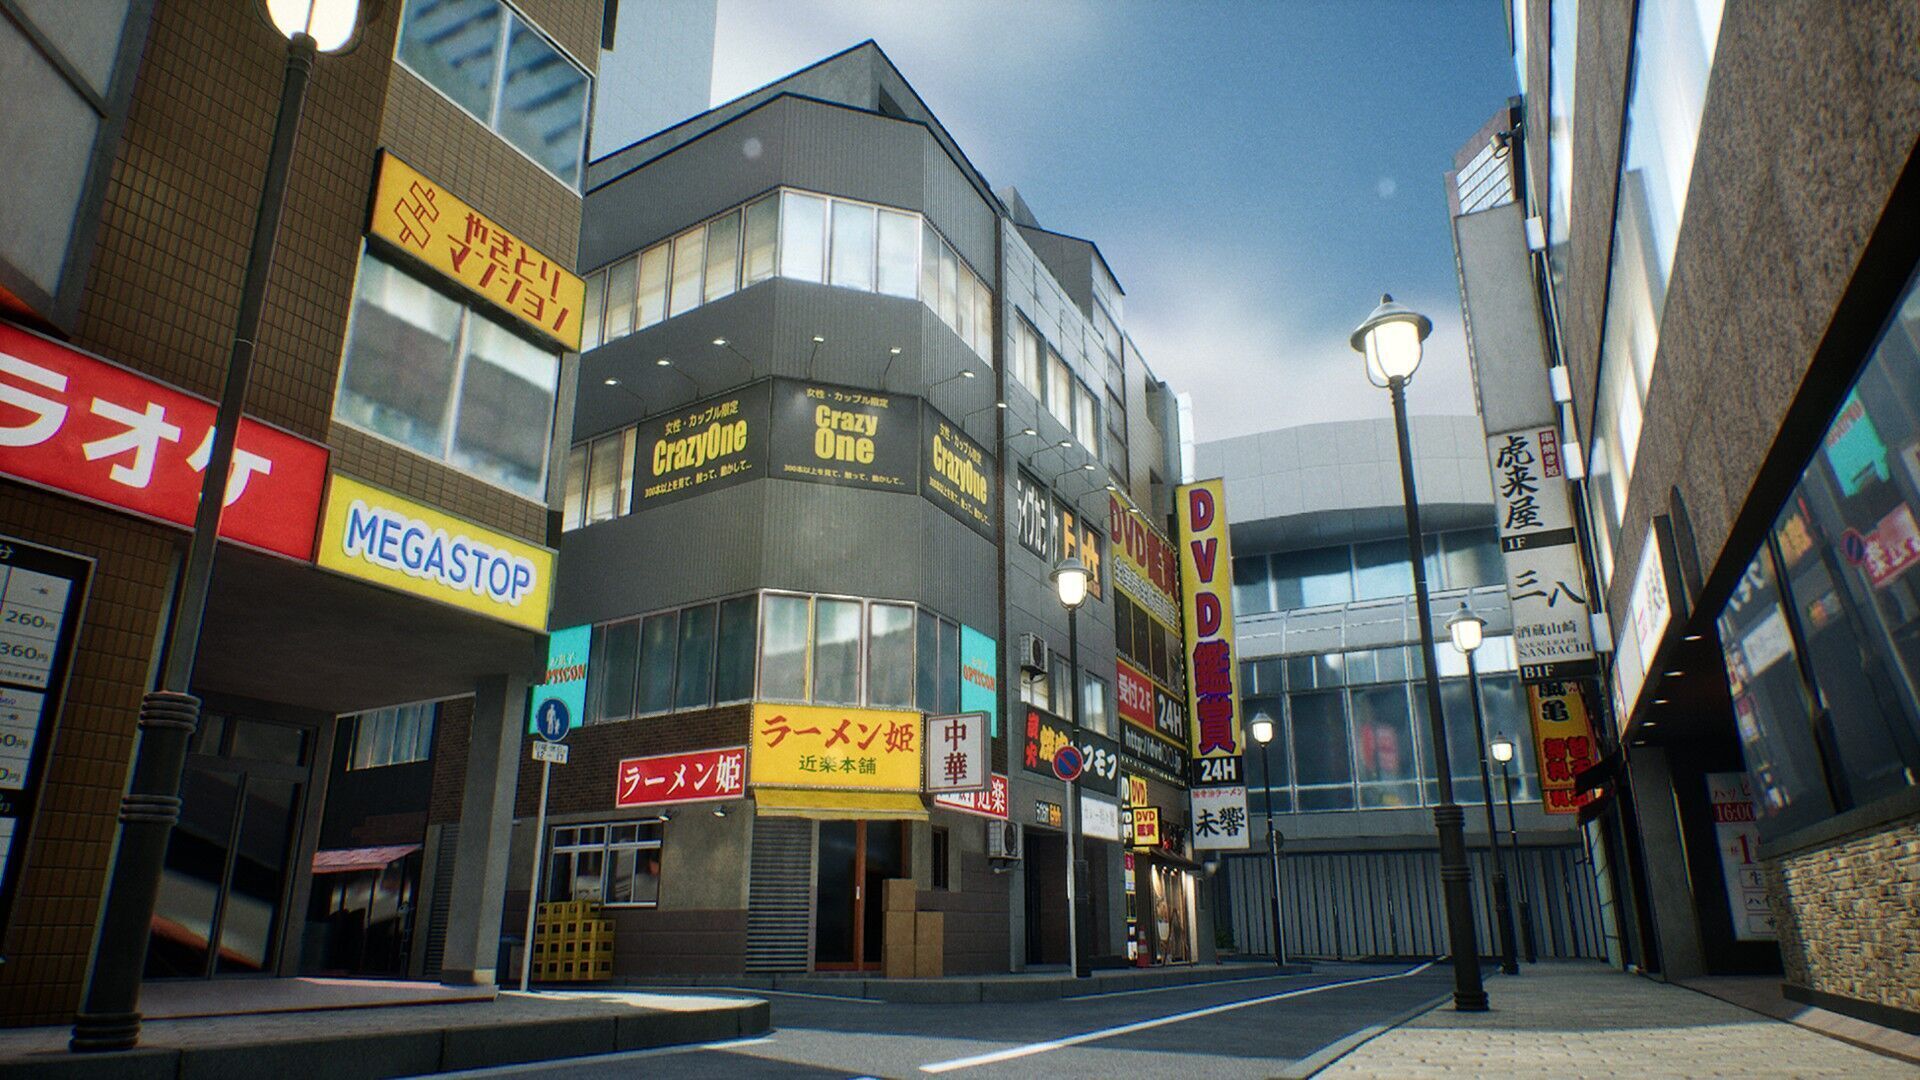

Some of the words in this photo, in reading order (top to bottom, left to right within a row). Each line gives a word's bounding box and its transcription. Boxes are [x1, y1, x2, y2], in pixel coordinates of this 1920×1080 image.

[463, 211, 562, 304] やきとり
[446, 233, 570, 332] マンション
[815, 404, 879, 437] Crazy
[652, 419, 748, 477] CrazyOne
[814, 428, 875, 465] One
[932, 434, 988, 506] CrazyOne
[1495, 434, 1544, 530] 虎来屋
[346, 507, 531, 600] MEGASTOP
[1507, 536, 1527, 550] 1F
[1511, 569, 1587, 608] 三八
[1519, 642, 1592, 658] SANBACHI
[1523, 665, 1554, 680] B1F
[761, 714, 915, 754] ラーメン姫
[1157, 693, 1183, 739] 24H
[798, 754, 877, 775] 近楽本舗
[943, 719, 968, 785] 中華
[1200, 758, 1237, 782] 24H
[620, 752, 742, 800] ラーメン姫
[1135, 810, 1156, 821] DVD
[1195, 806, 1246, 838] 未響
